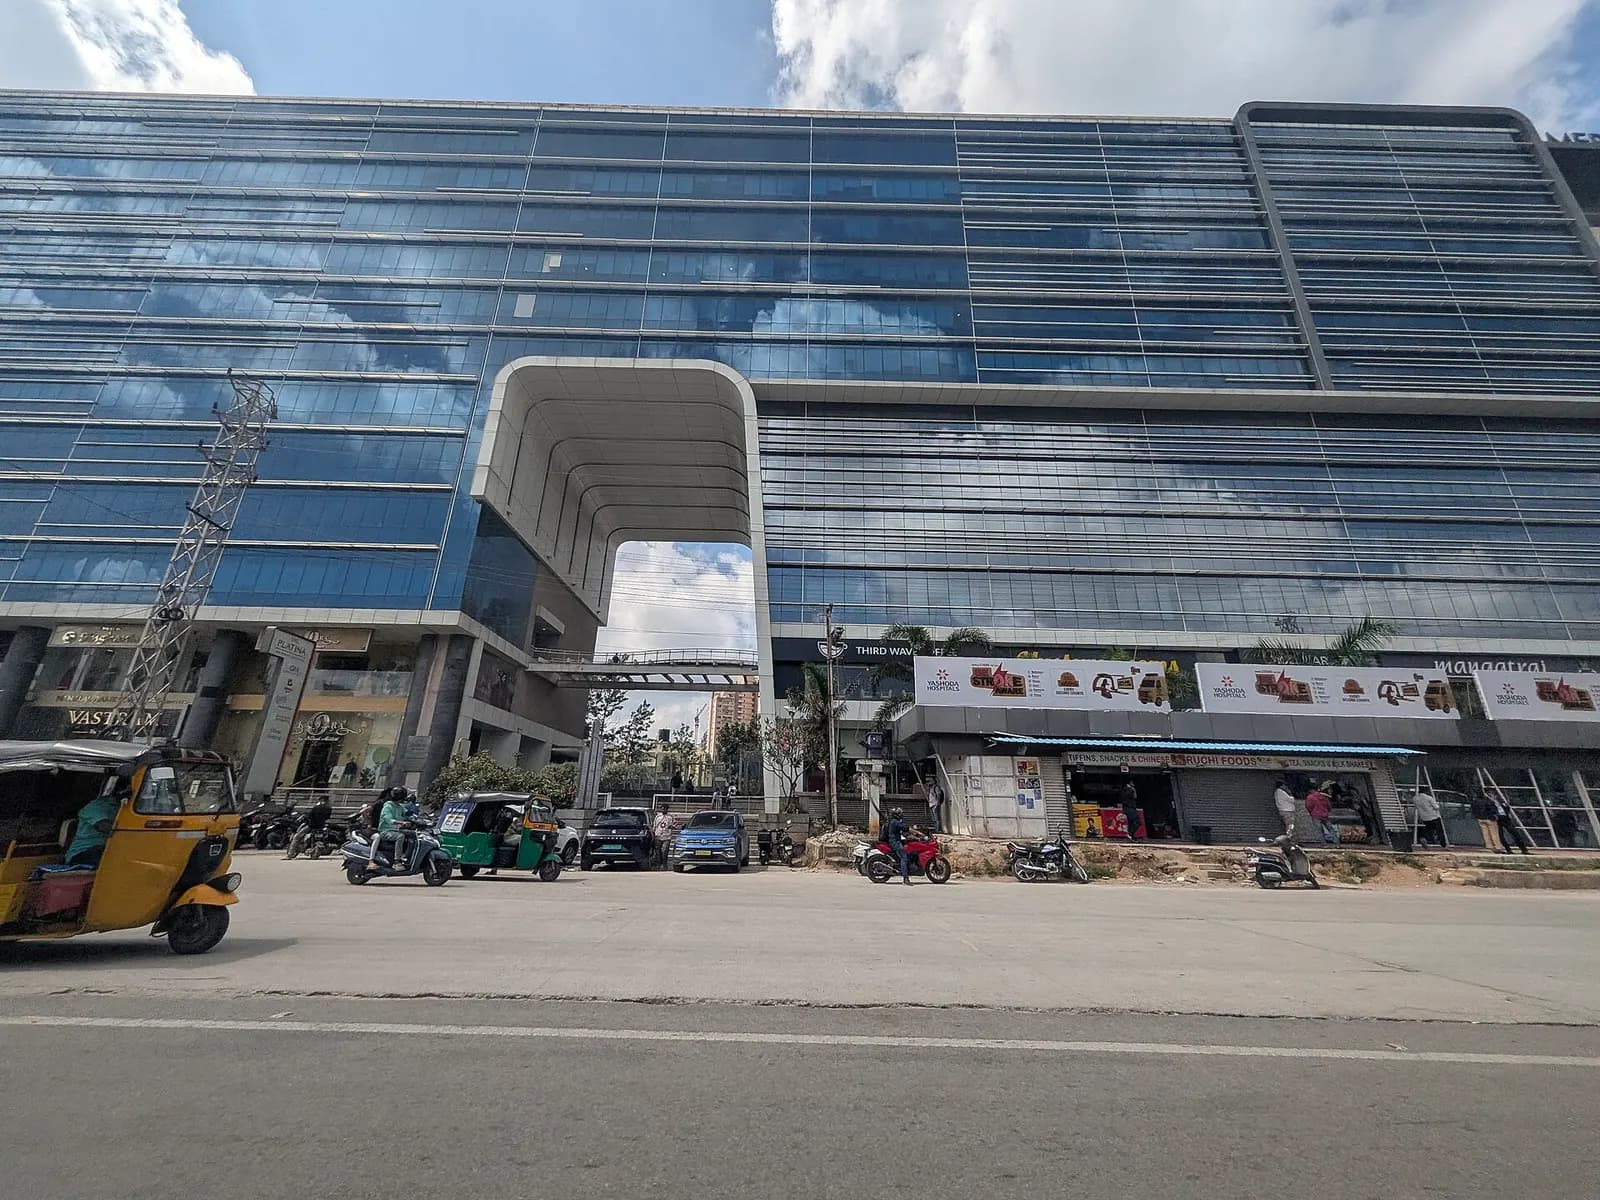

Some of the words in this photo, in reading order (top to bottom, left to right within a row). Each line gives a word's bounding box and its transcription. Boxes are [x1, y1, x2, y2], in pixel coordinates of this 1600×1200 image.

[856, 646, 887, 655] THIRD
[995, 687, 1025, 695] AWARE
[1187, 755, 1219, 765] RUCHI
[1221, 756, 1257, 766] FOODS
